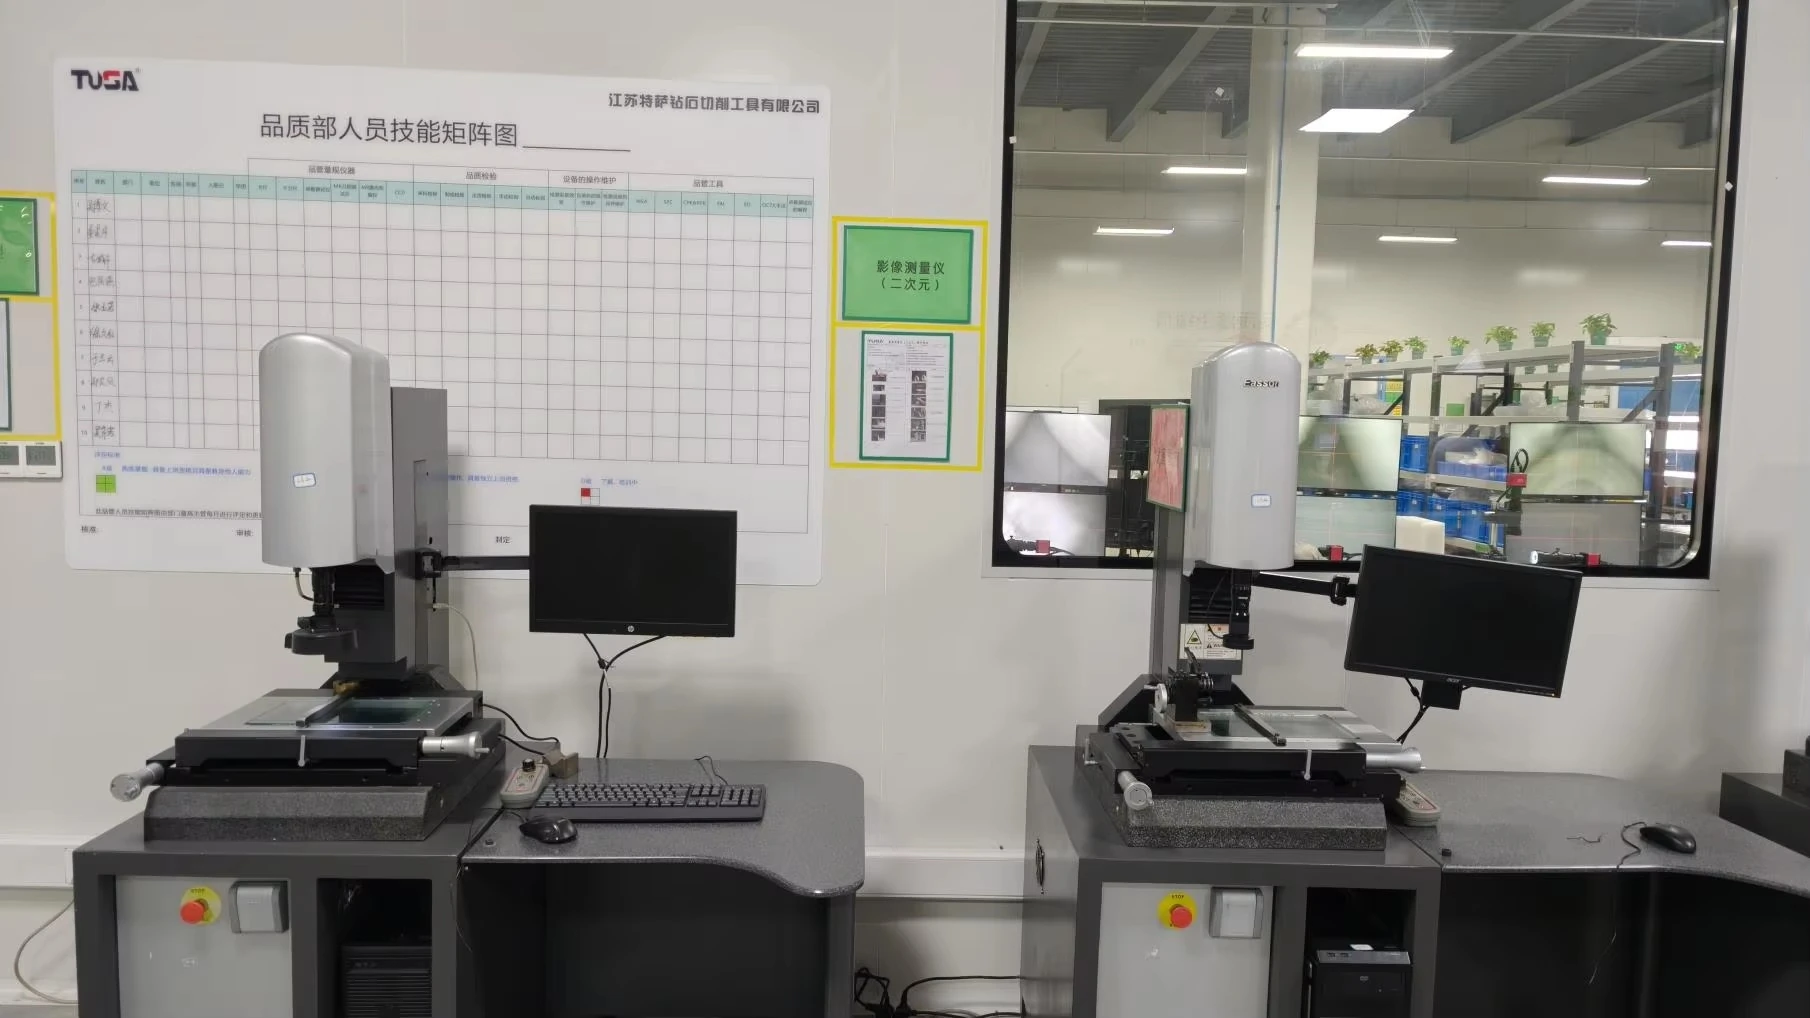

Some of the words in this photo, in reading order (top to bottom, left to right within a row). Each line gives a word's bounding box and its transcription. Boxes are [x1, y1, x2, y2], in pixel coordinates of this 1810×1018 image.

[71, 69, 139, 91] TUSA
[608, 92, 820, 114] 江苏特萨钻石切削工具有限公司
[260, 113, 517, 148] 品质部人员技能矩阵图
[876, 260, 945, 276] 影像测量仪
